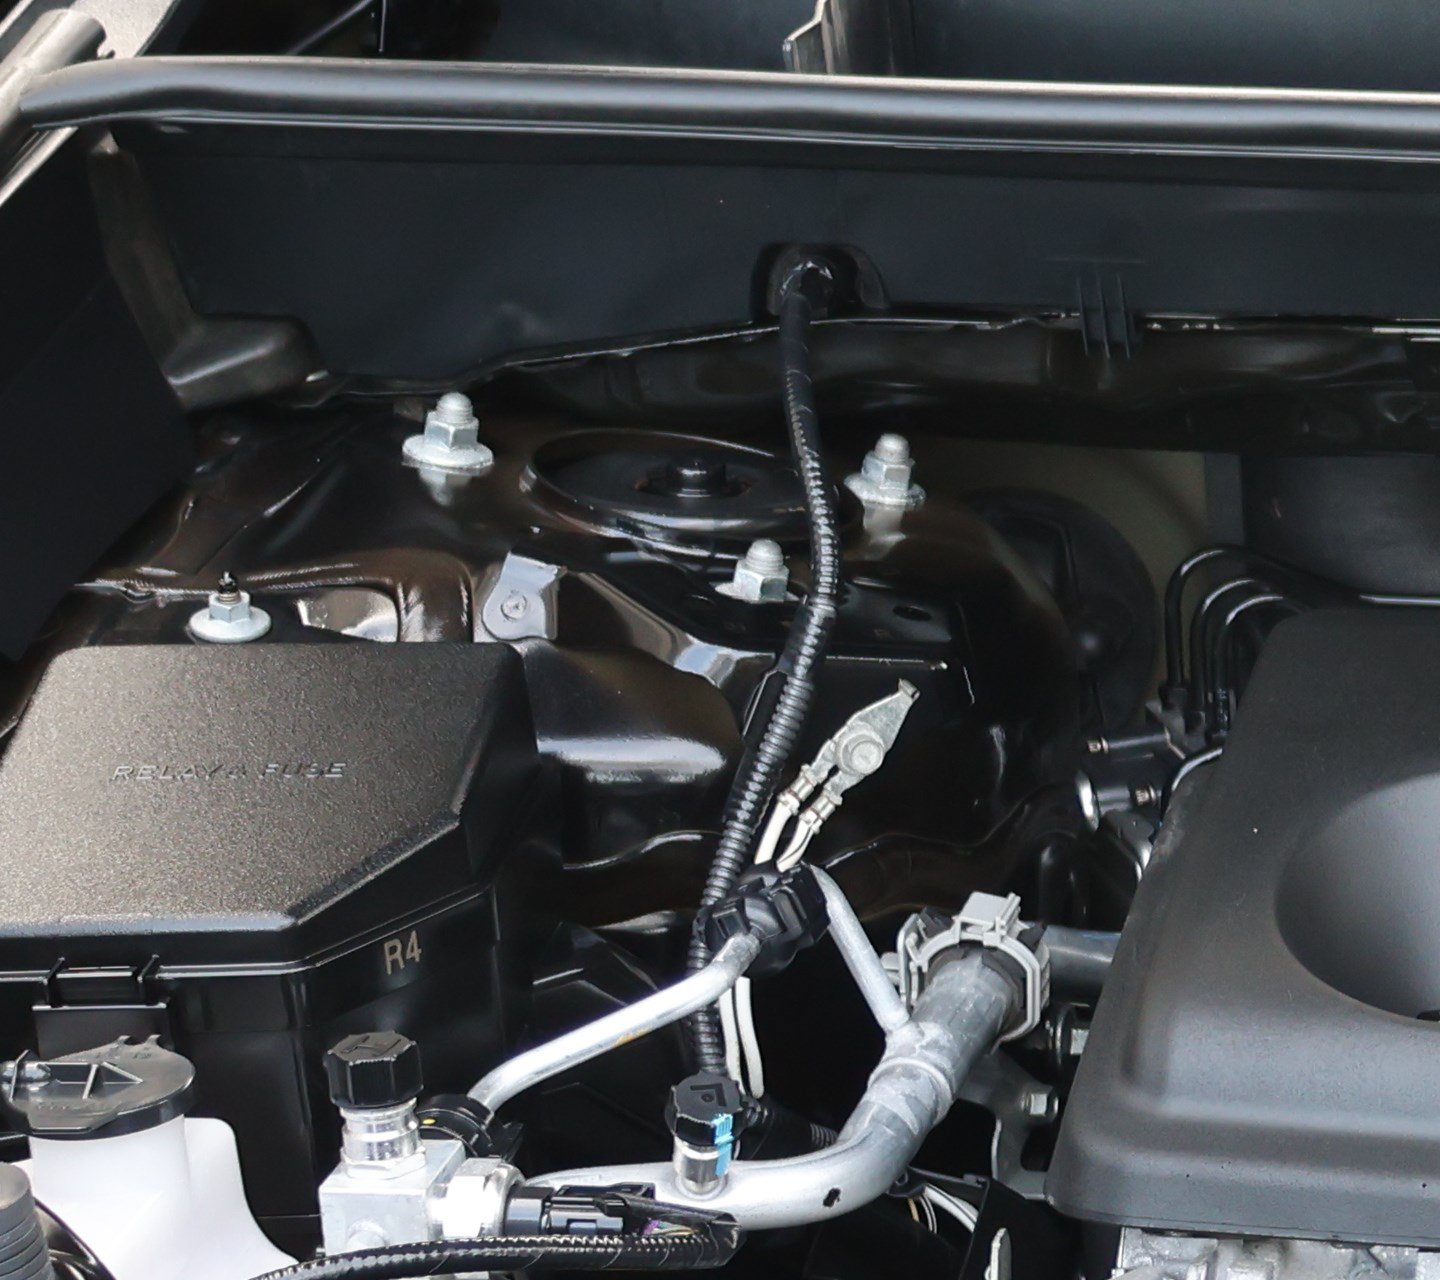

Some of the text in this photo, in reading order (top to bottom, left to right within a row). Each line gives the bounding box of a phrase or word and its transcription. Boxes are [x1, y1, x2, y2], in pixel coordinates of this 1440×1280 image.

[111, 764, 224, 781] RELAY
[259, 762, 347, 780] FUSE
[383, 930, 422, 975] R4
